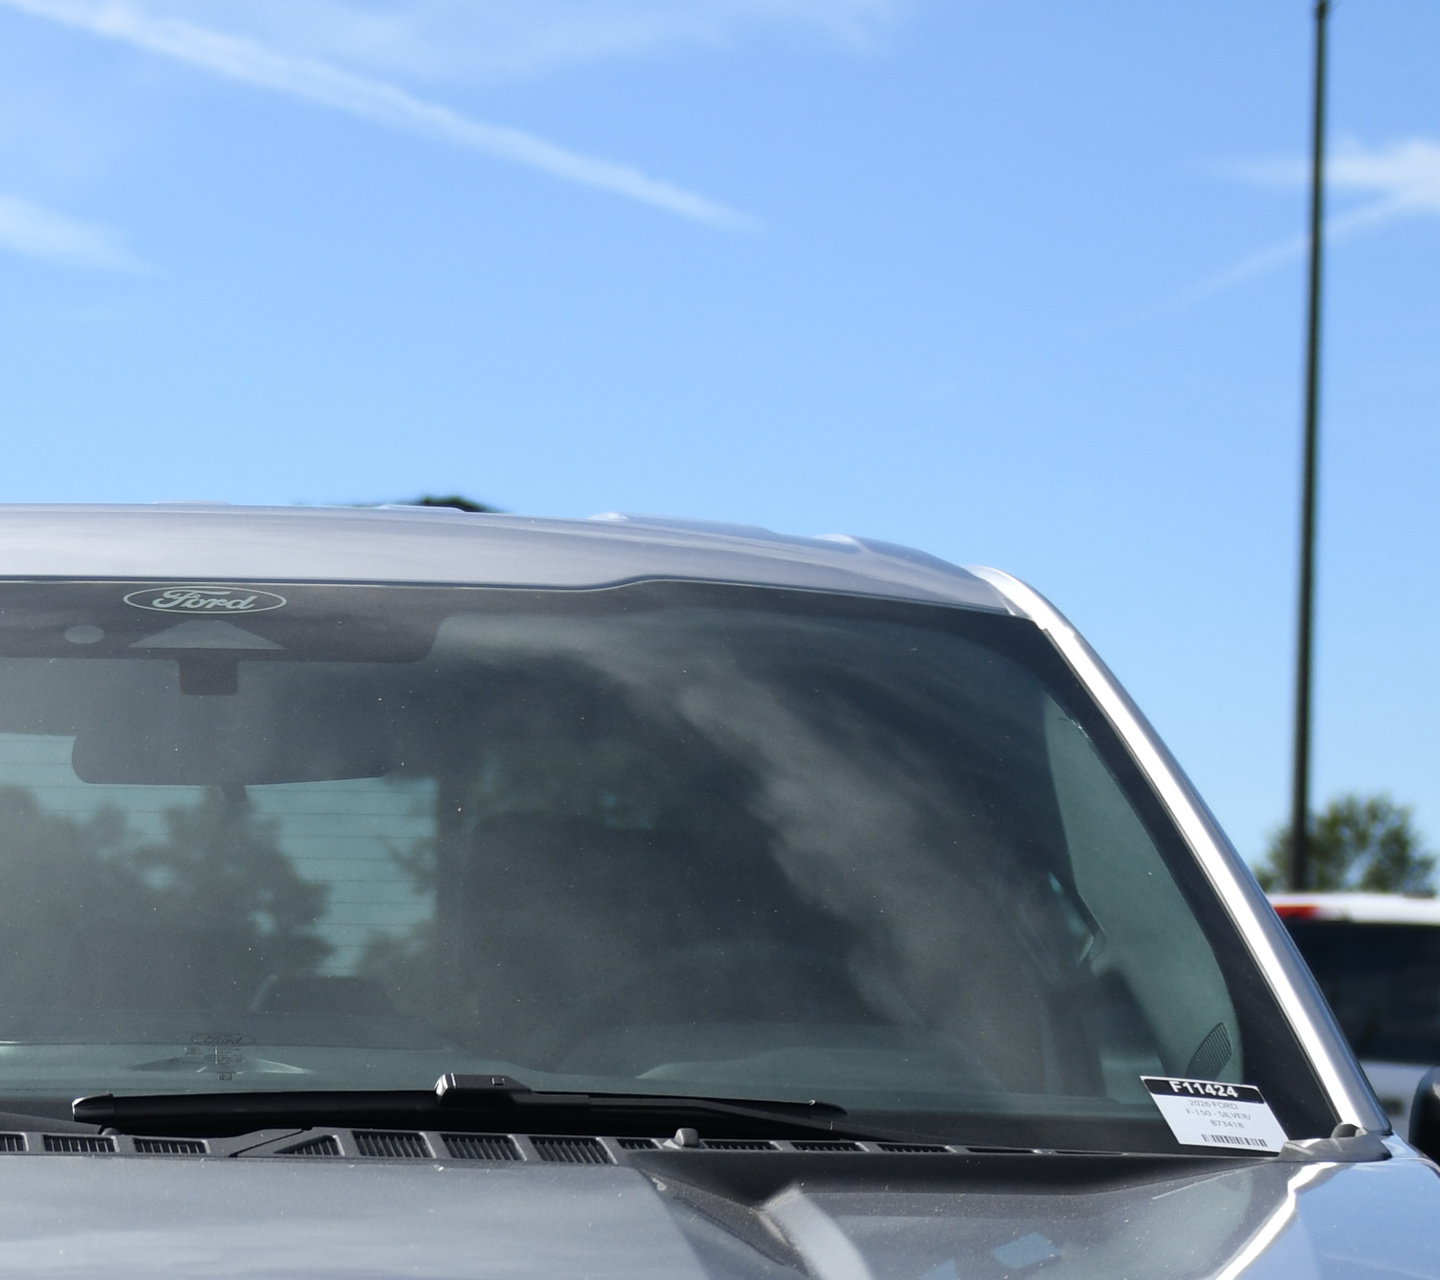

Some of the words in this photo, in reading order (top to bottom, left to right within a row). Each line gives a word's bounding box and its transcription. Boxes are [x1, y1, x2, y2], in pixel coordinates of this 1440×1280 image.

[152, 589, 258, 610] Ford
[1169, 1081, 1239, 1098] F11424
[1189, 1100, 1212, 1108] 2026
[1212, 1101, 1239, 1110] FORD
